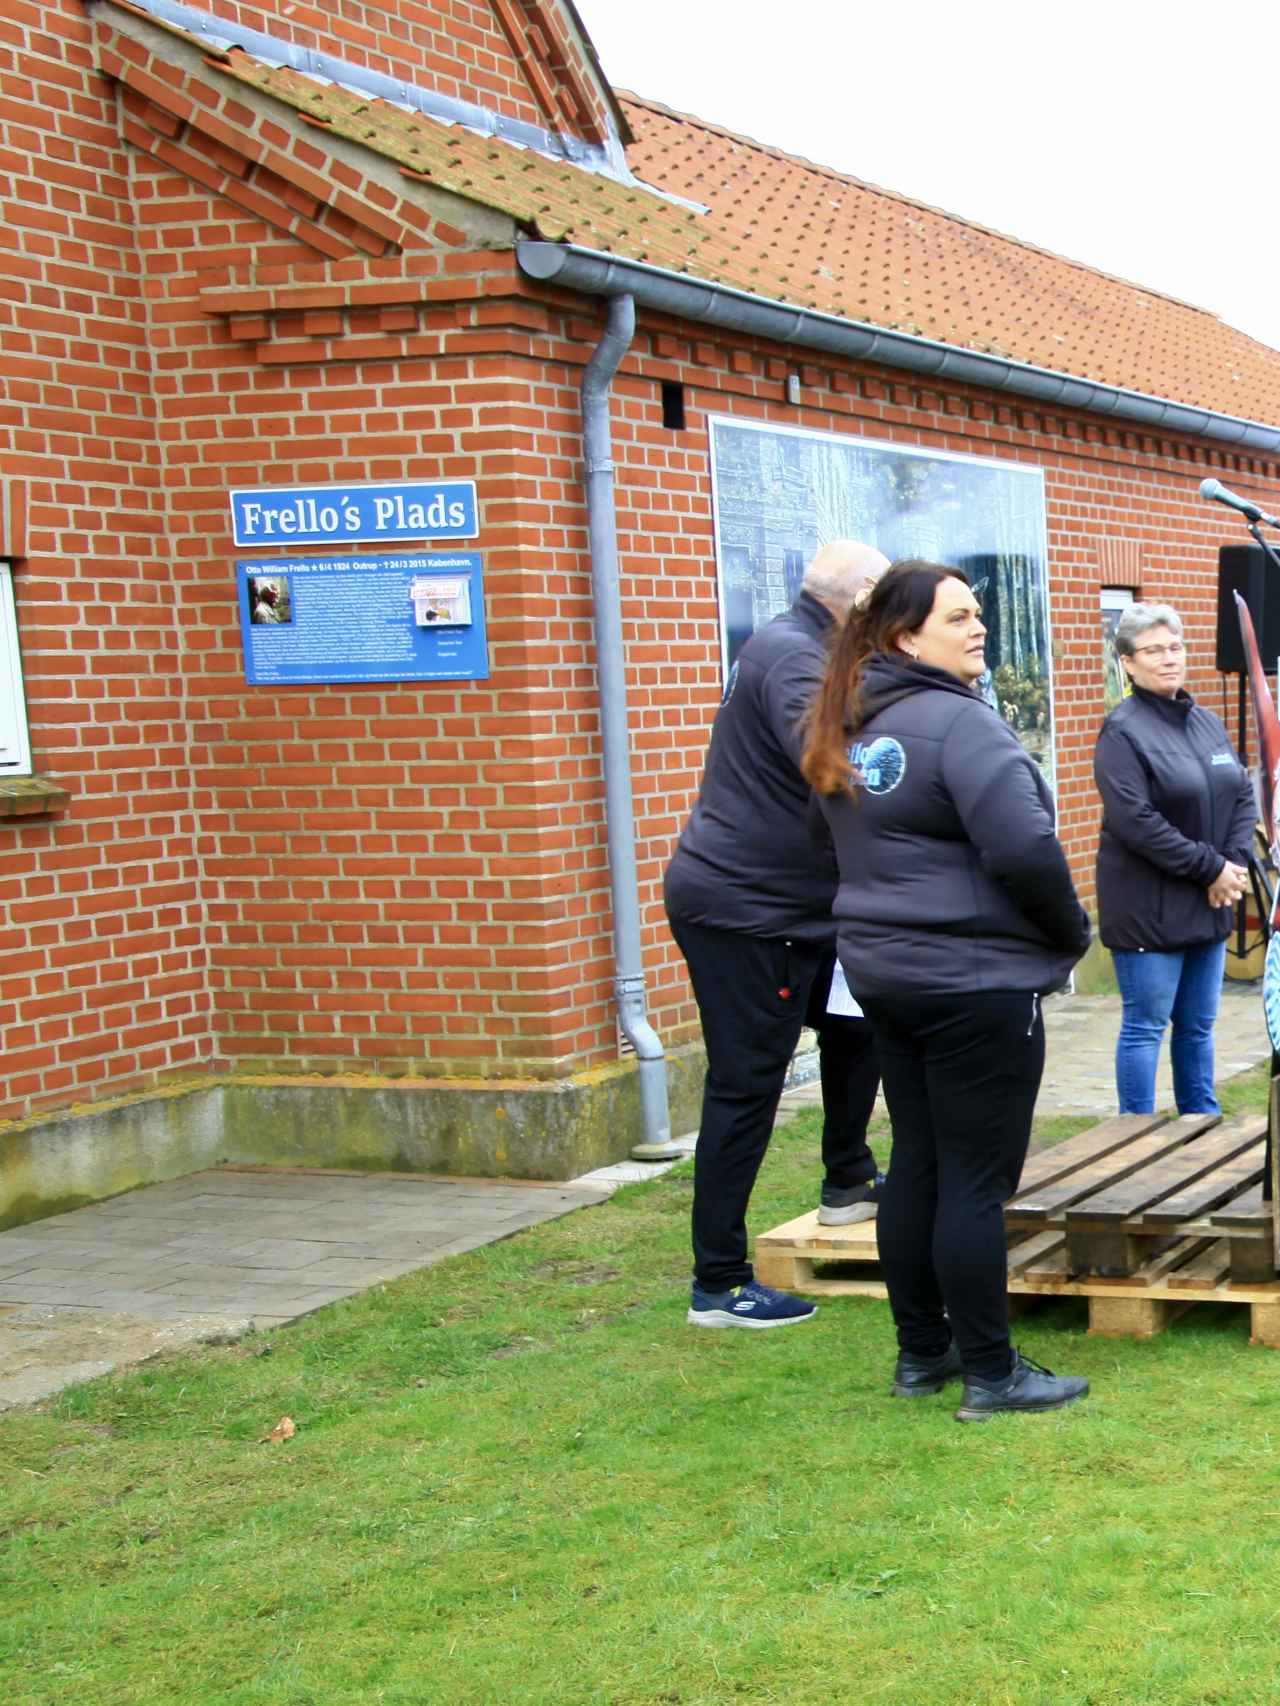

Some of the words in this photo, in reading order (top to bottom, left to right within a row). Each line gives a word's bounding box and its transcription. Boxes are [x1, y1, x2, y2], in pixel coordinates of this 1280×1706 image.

[241, 496, 361, 535] Frello's
[373, 494, 466, 530] Plads
[262, 565, 288, 574] William
[289, 564, 310, 573] Frello
